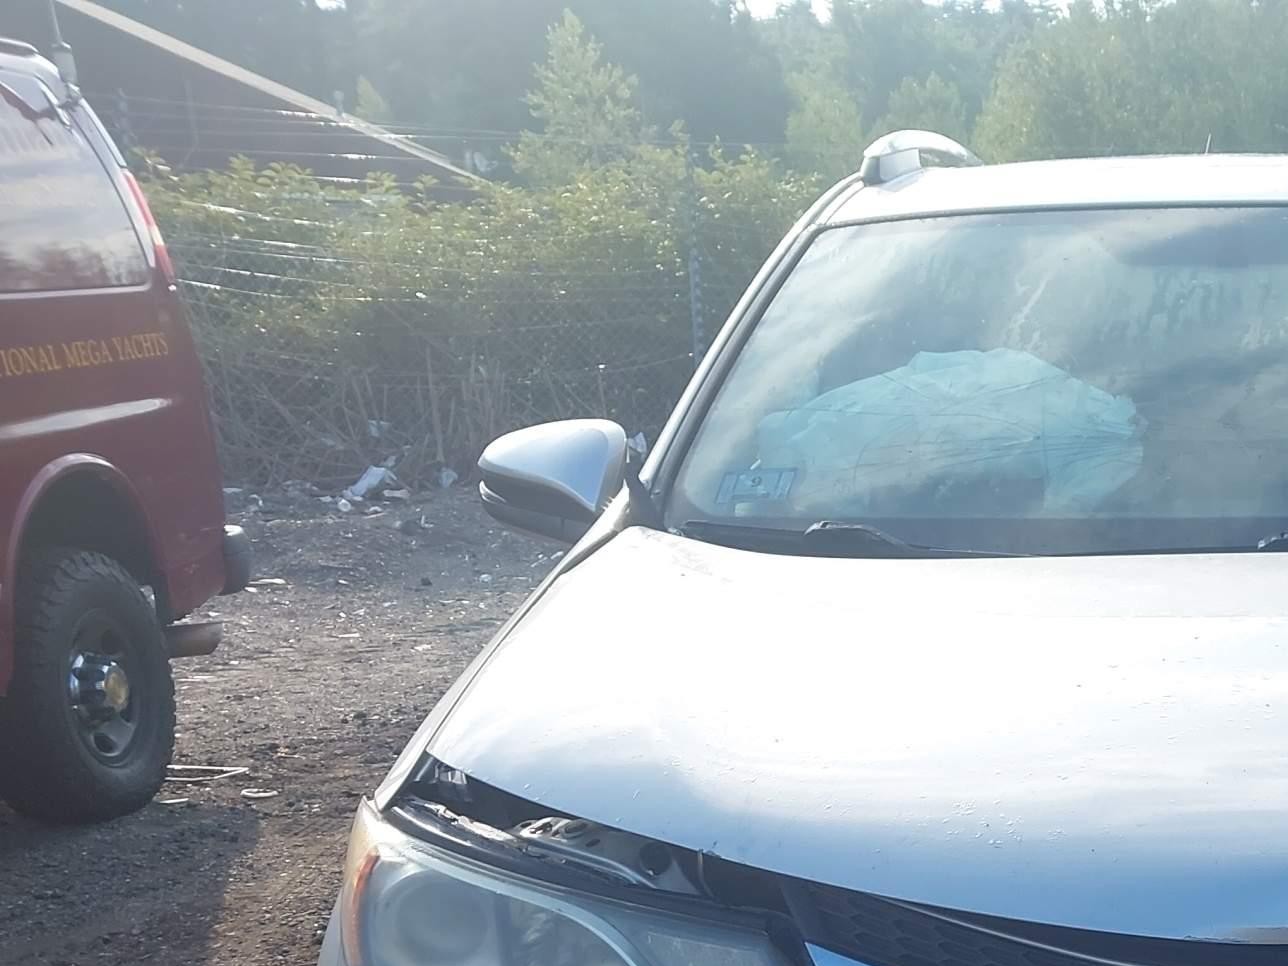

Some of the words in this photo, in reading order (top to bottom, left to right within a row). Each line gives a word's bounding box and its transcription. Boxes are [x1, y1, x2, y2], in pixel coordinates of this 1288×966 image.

[0, 344, 62, 377] IONAL
[62, 339, 113, 369] MEGA
[111, 332, 169, 361] YACHTS
